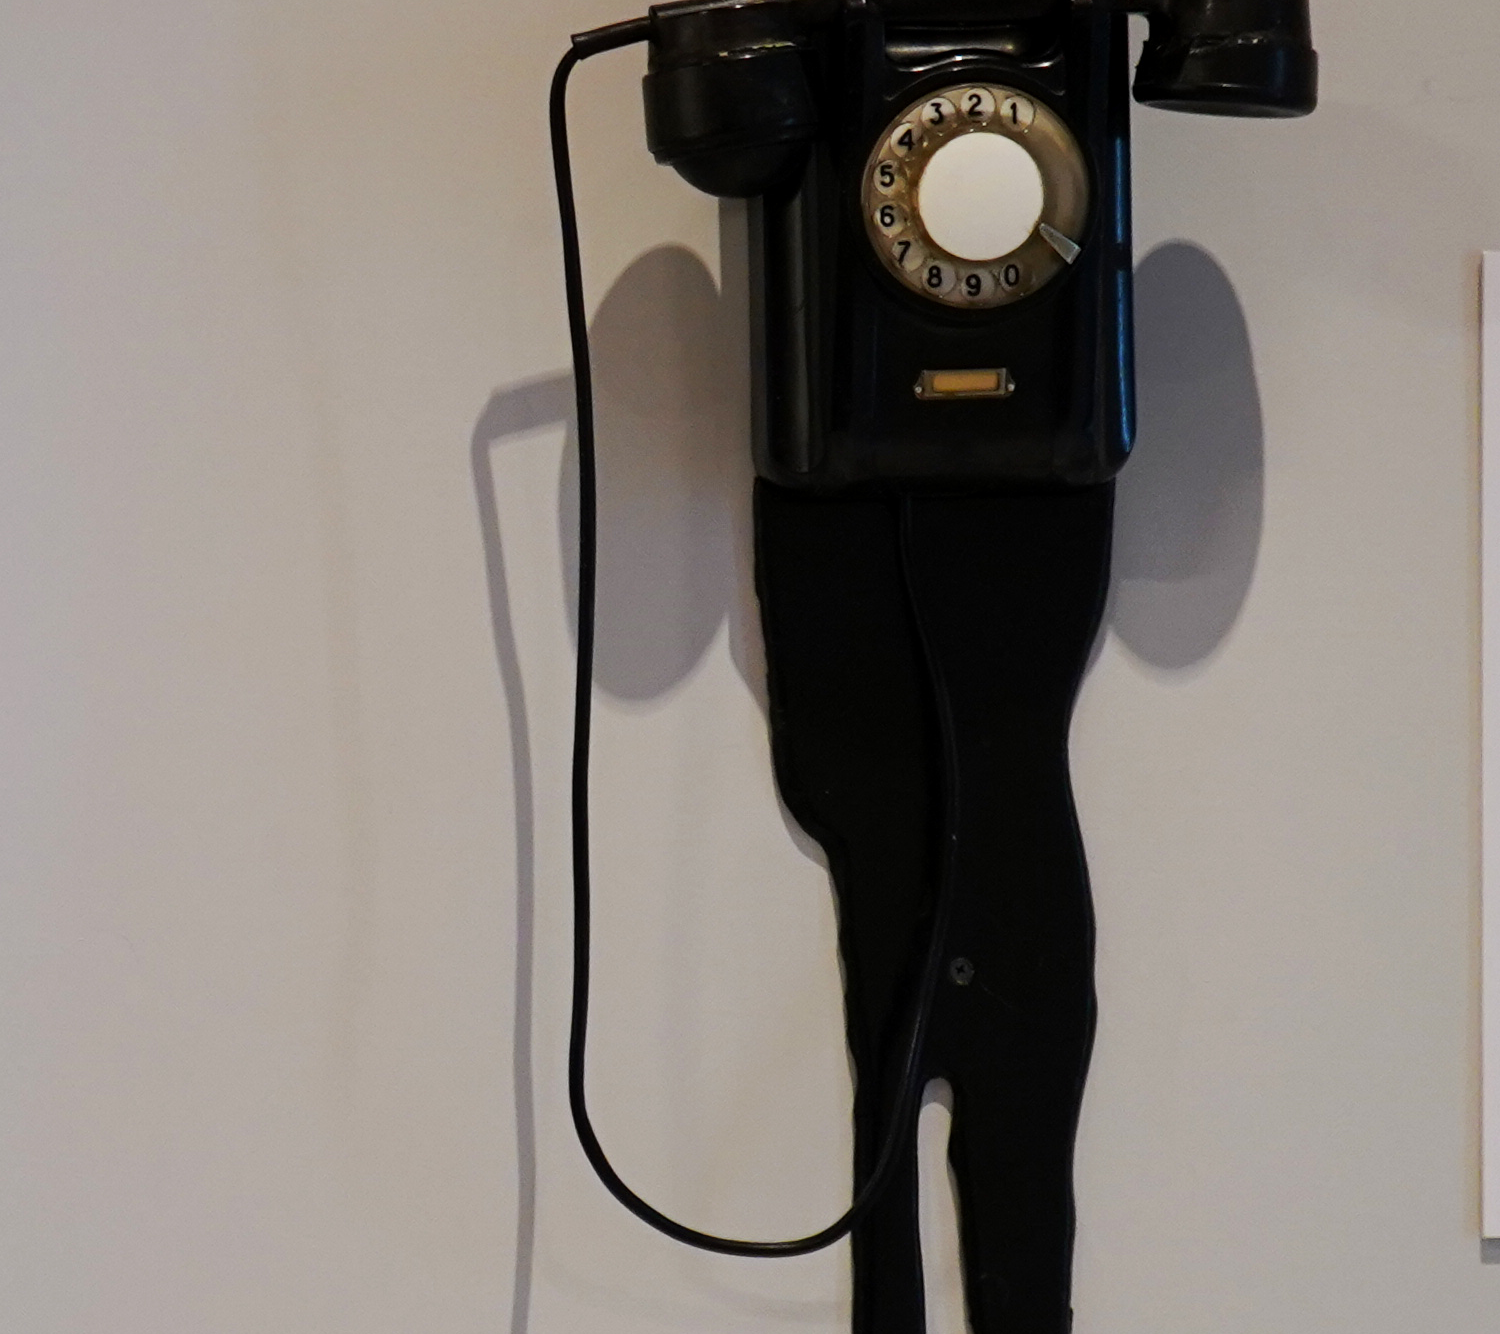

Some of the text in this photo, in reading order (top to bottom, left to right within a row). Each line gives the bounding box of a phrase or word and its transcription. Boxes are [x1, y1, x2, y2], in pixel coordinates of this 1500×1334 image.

[880, 94, 1019, 296] 1 2 3 4 5 6 7 8 9 0
